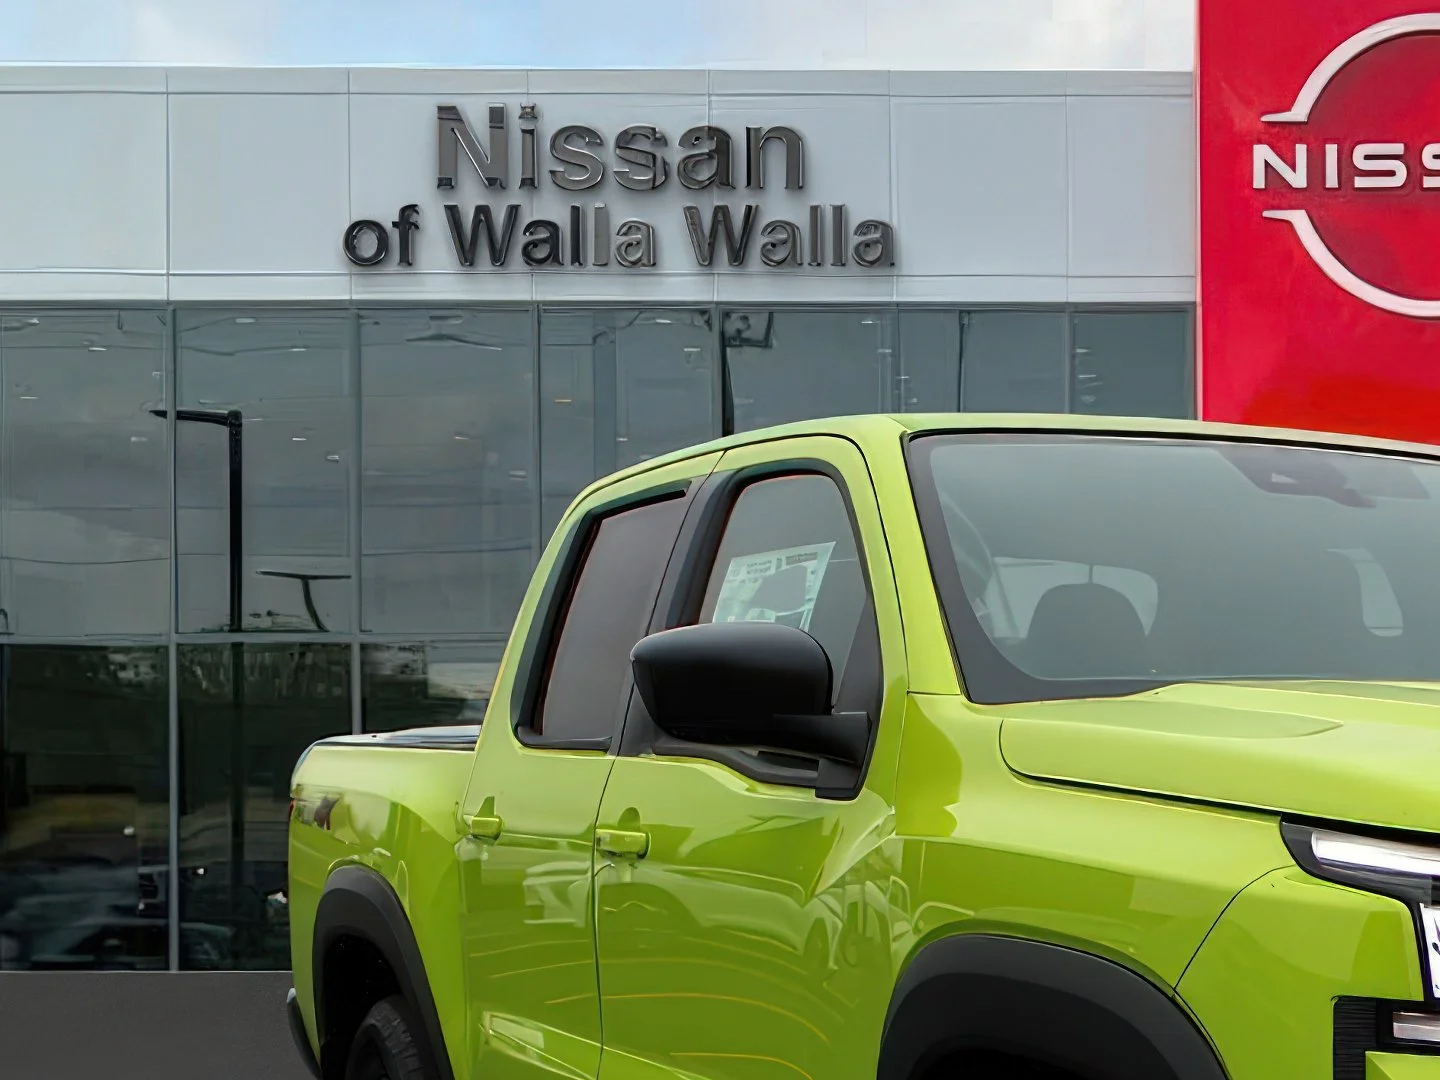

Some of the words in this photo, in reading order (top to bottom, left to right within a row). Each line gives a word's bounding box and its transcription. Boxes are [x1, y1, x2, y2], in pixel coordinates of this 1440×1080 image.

[436, 102, 805, 191] Nissan
[343, 204, 420, 267] of
[444, 203, 656, 268] Walla
[682, 203, 896, 268] Walla
